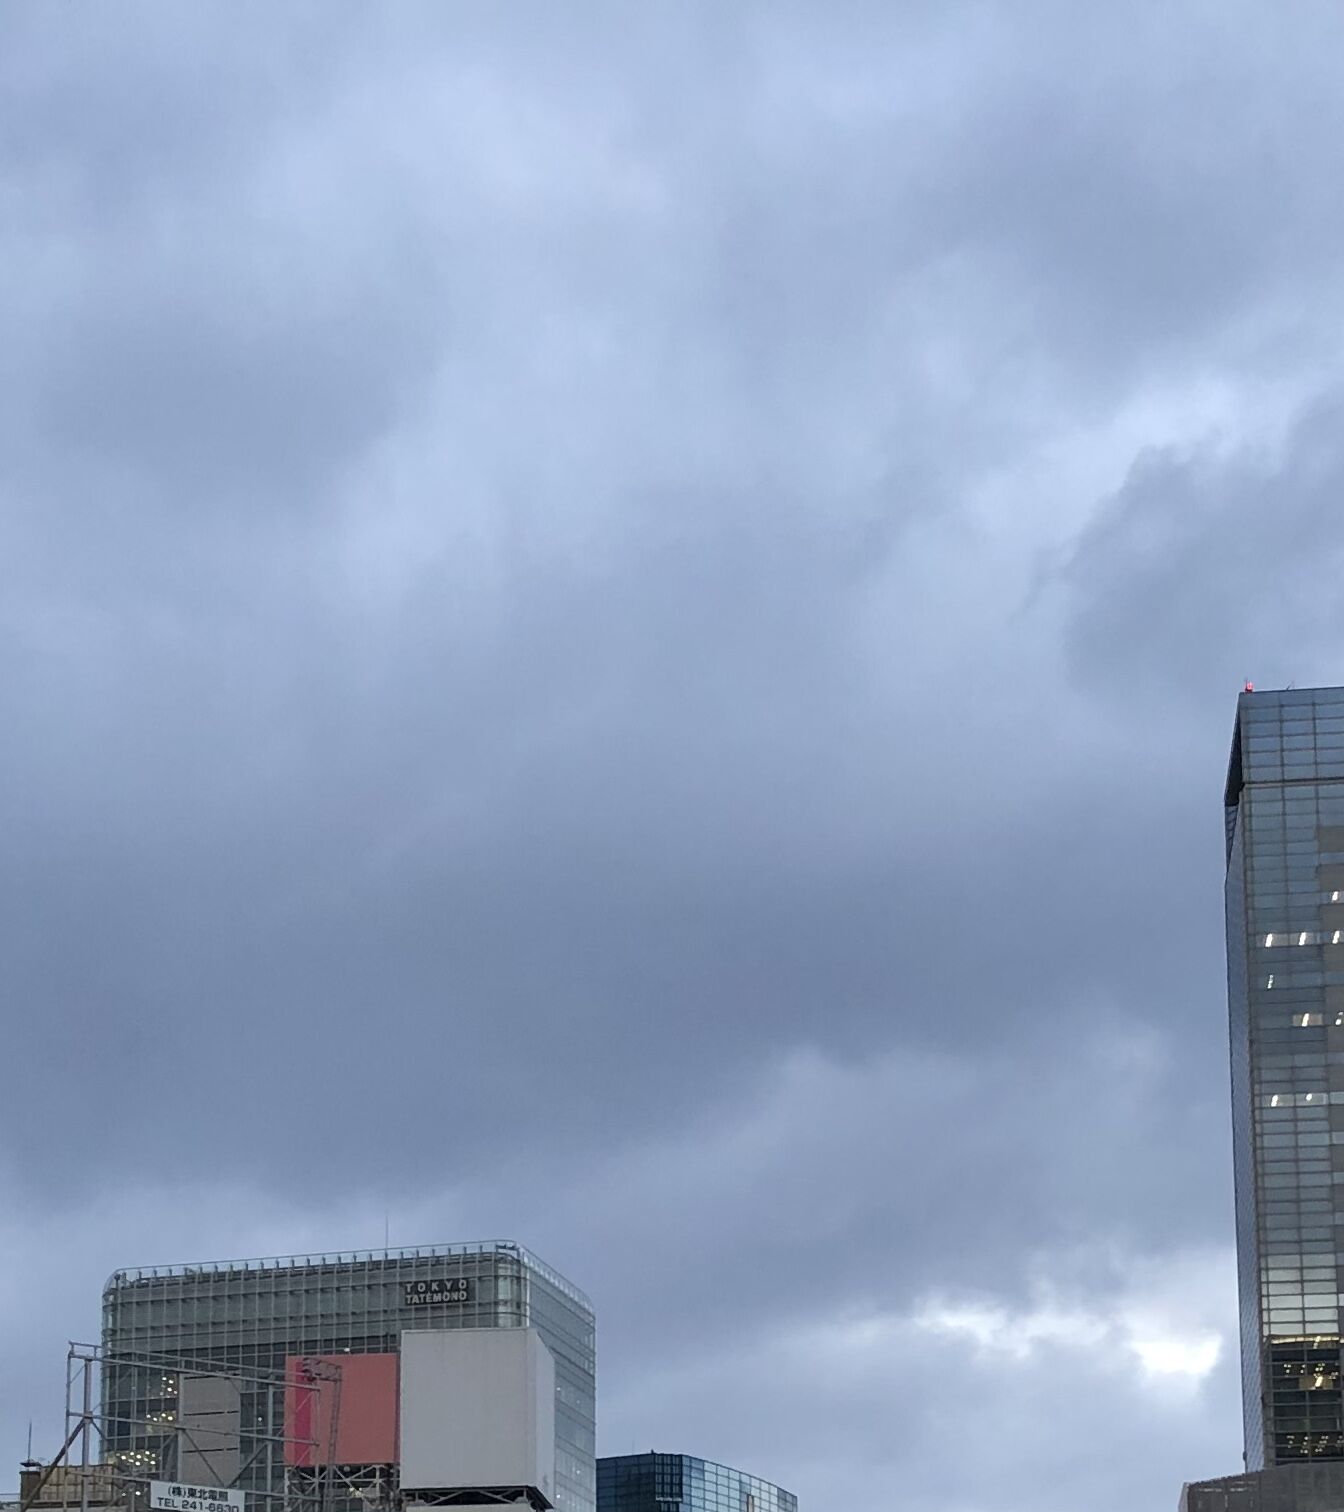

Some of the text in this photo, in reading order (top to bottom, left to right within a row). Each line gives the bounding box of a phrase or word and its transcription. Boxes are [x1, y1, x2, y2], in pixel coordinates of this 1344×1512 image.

[406, 1280, 467, 1293] TOKYO
[406, 1291, 467, 1304] TATEMONO
[157, 1497, 178, 1509] TEL
